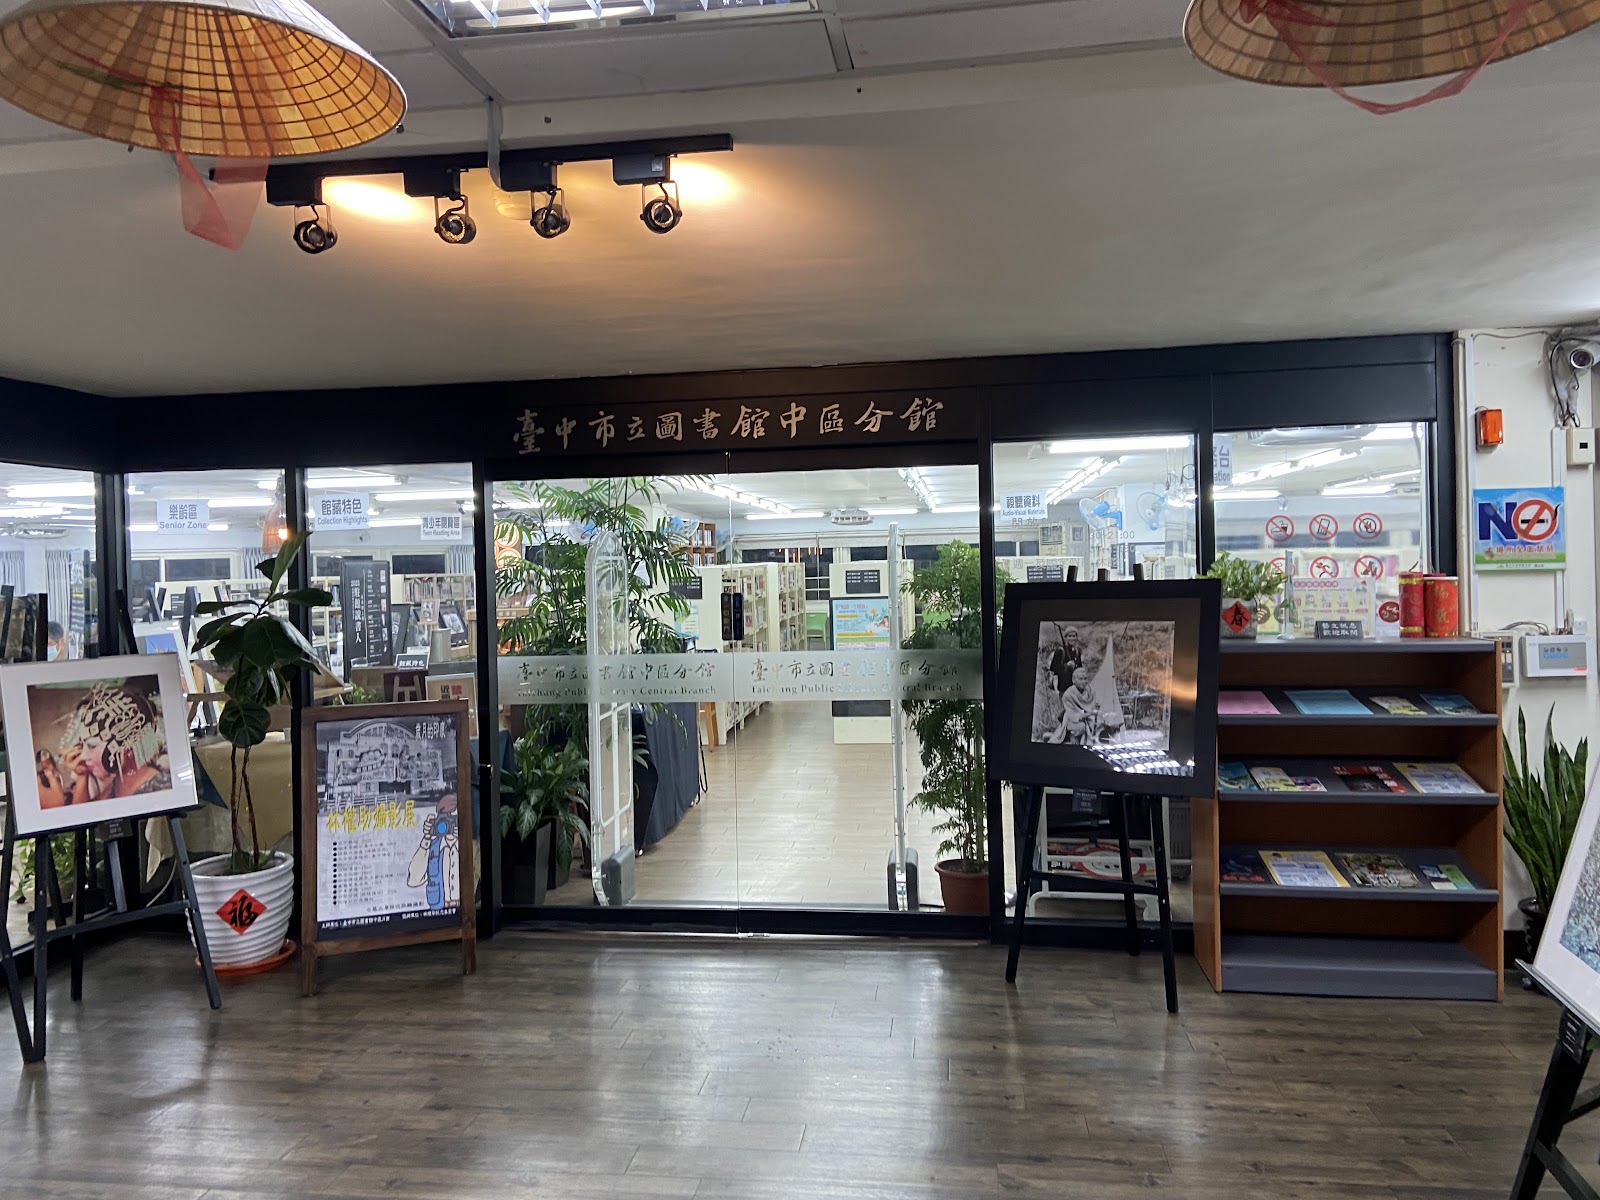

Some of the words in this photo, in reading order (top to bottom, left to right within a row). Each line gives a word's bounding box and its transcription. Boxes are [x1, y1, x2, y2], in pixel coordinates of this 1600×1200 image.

[513, 397, 944, 455] 臺中市立圖書館中區分館
[321, 499, 362, 516] 館藏特色
[1006, 495, 1040, 508] 視聽資料
[169, 504, 197, 519] 樂齡區
[159, 521, 185, 529] Senior
[187, 521, 207, 529] Zone
[317, 517, 342, 525] Collection
[343, 515, 368, 525] Highlights
[422, 516, 460, 529] 青少年閱覽區
[1231, 603, 1248, 627] 春
[640, 686, 677, 696] Central
[681, 686, 717, 695] Branch
[801, 683, 835, 693] Public
